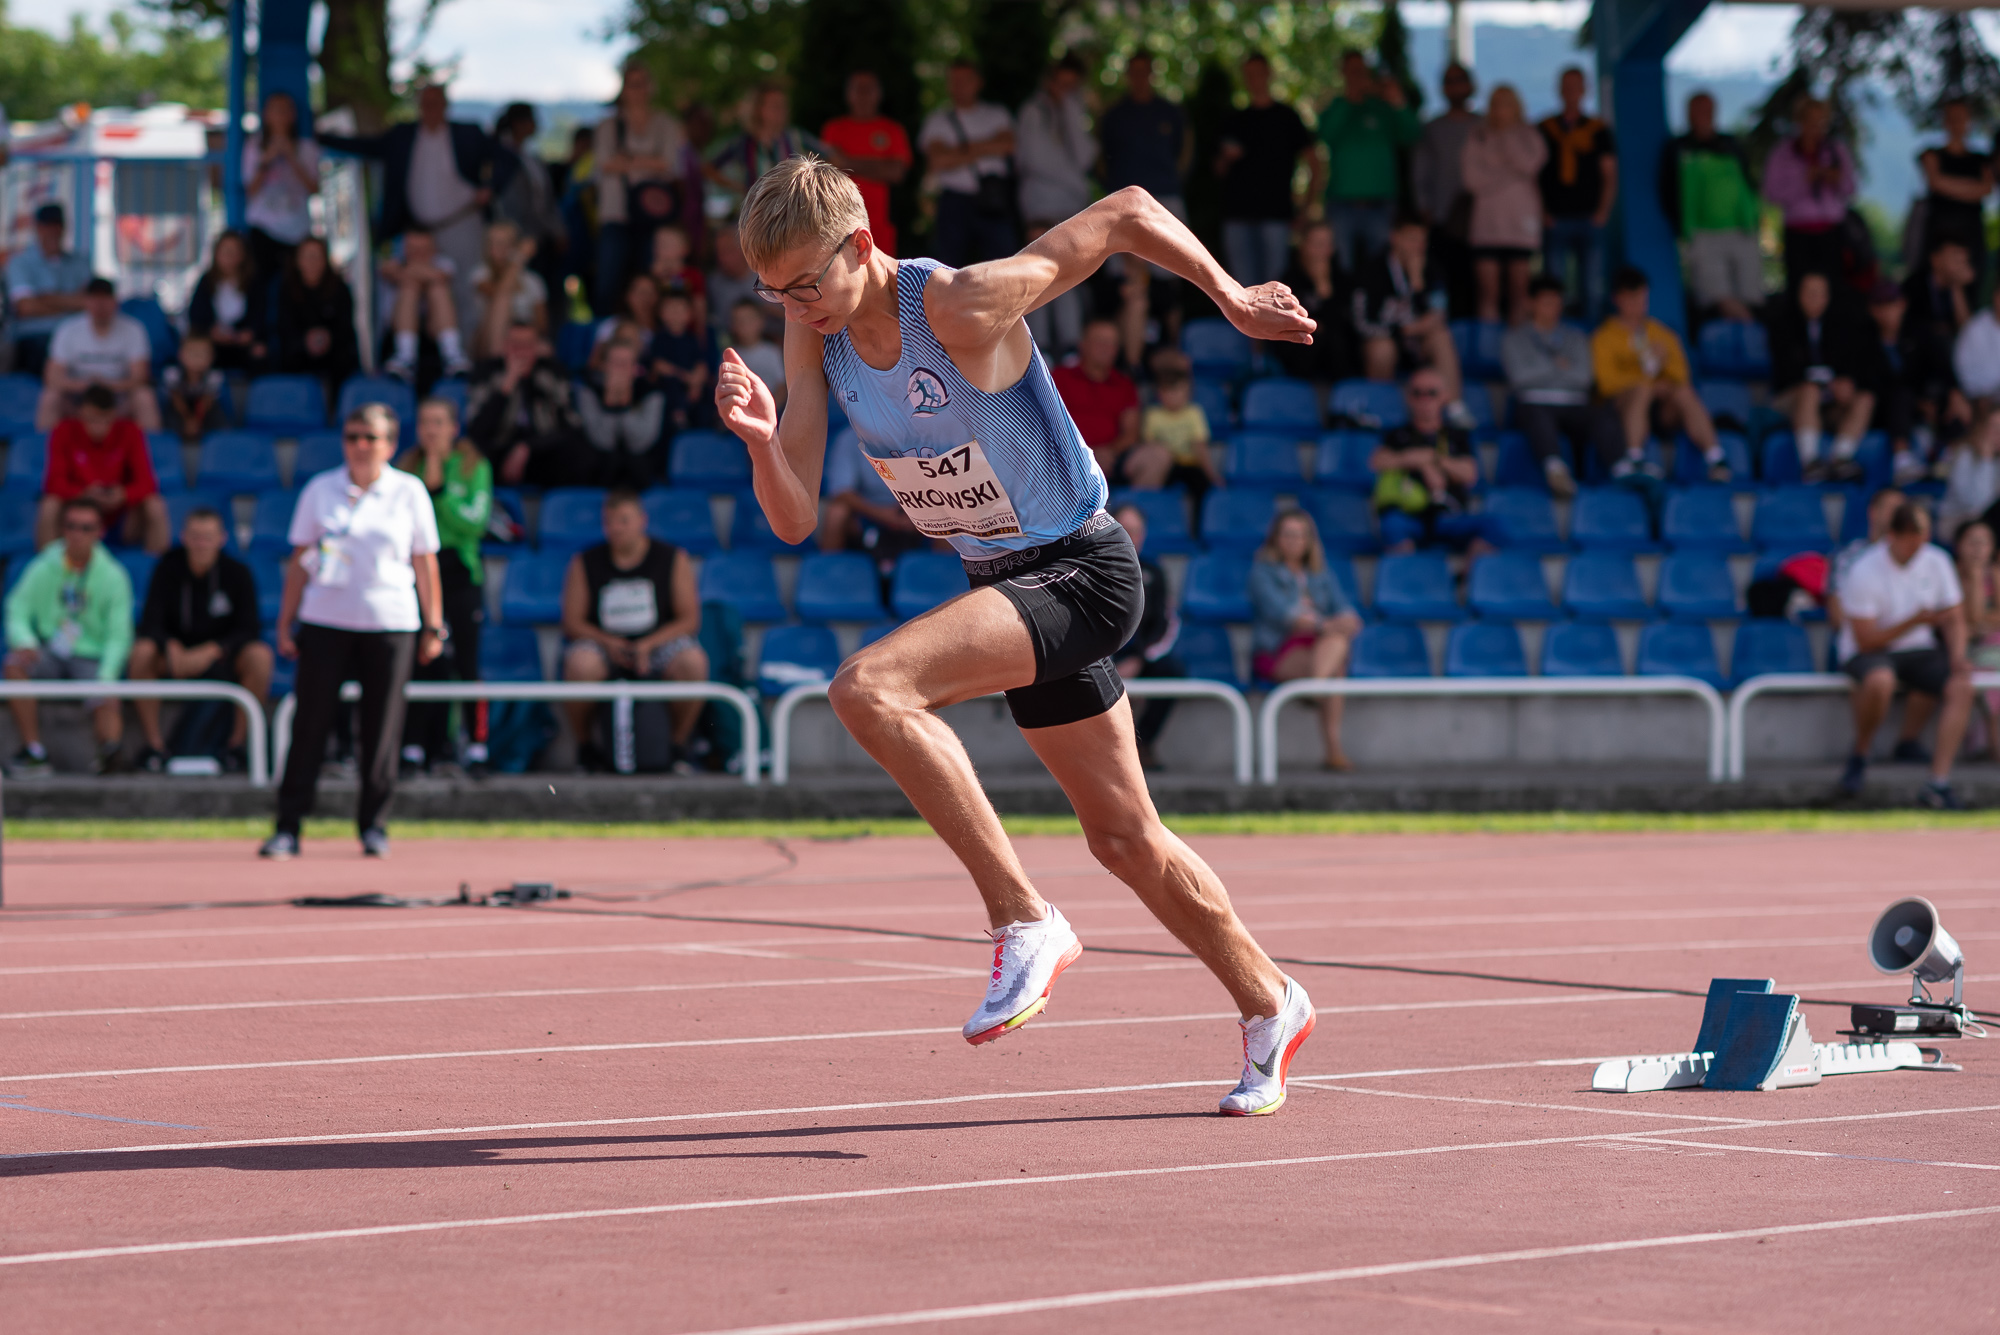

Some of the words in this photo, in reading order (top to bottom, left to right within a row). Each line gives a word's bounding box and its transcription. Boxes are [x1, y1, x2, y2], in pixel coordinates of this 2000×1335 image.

[917, 446, 971, 479] 547
[972, 519, 998, 530] Polski
[999, 515, 1016, 524] U18
[1063, 513, 1112, 546] NIKE
[962, 560, 993, 576] NIKE
[993, 546, 1041, 575] PRO
